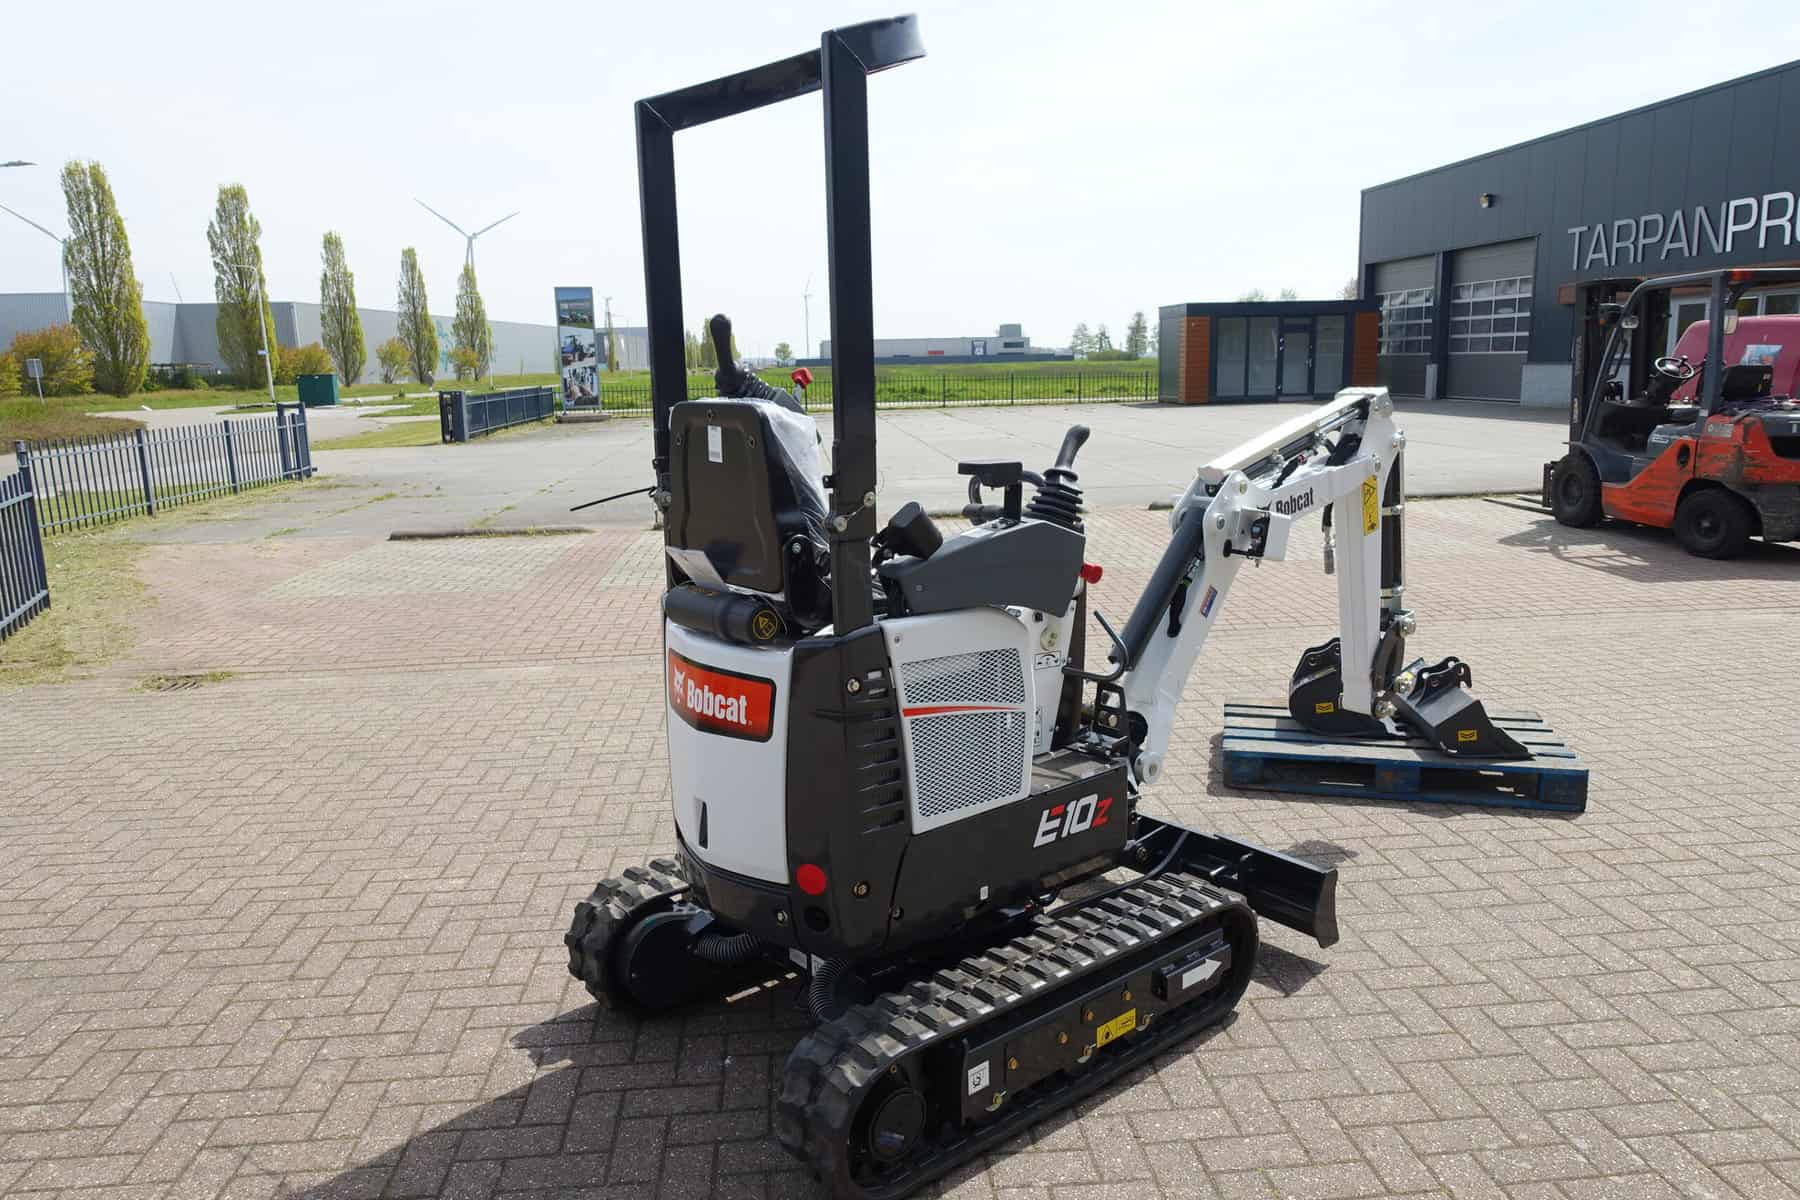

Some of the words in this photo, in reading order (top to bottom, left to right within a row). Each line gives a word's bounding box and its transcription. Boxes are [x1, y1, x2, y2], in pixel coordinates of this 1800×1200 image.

[1567, 191, 1800, 271] TARPANPR
[1275, 487, 1315, 516] Bobcat
[687, 678, 748, 726] Bobcat
